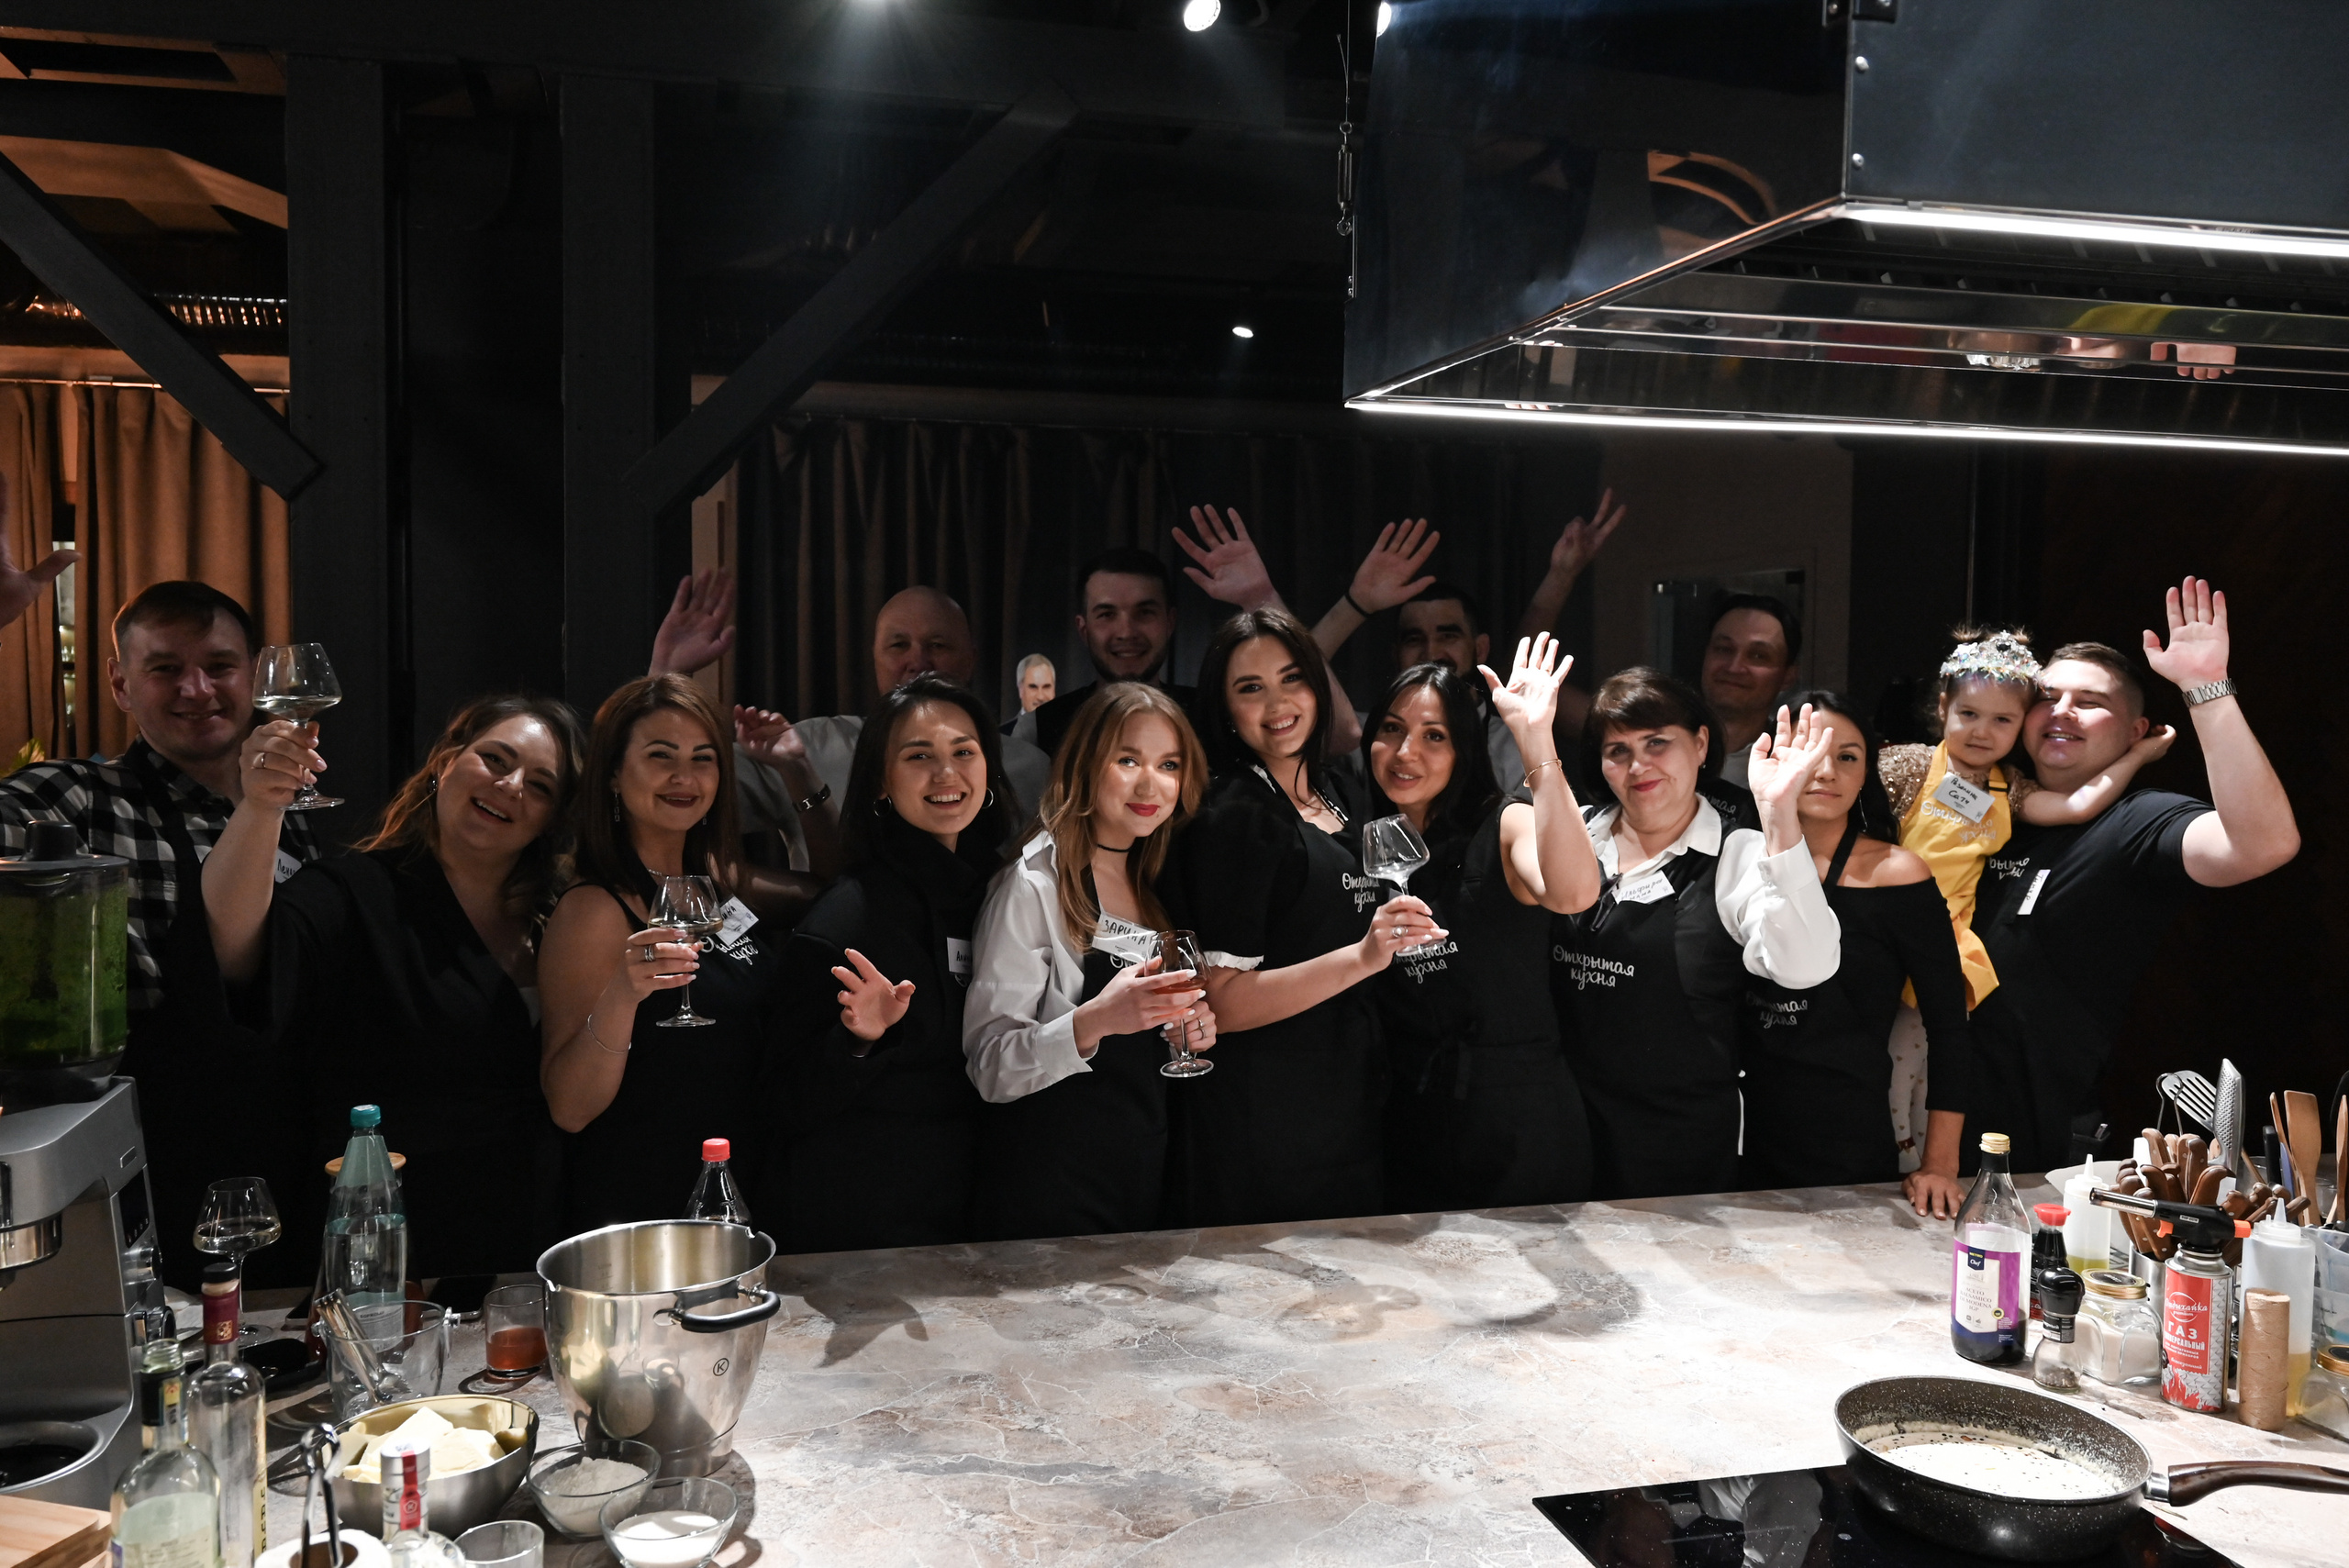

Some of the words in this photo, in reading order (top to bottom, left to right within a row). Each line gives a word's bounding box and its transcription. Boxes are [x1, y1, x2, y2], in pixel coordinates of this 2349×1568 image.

[1404, 959, 1448, 984] кухня
[1553, 944, 1635, 977] Открытая
[1570, 967, 1616, 991] кухня
[1965, 1287, 1985, 1296] ACETO
[2168, 1321, 2198, 1340] ГАЗ
